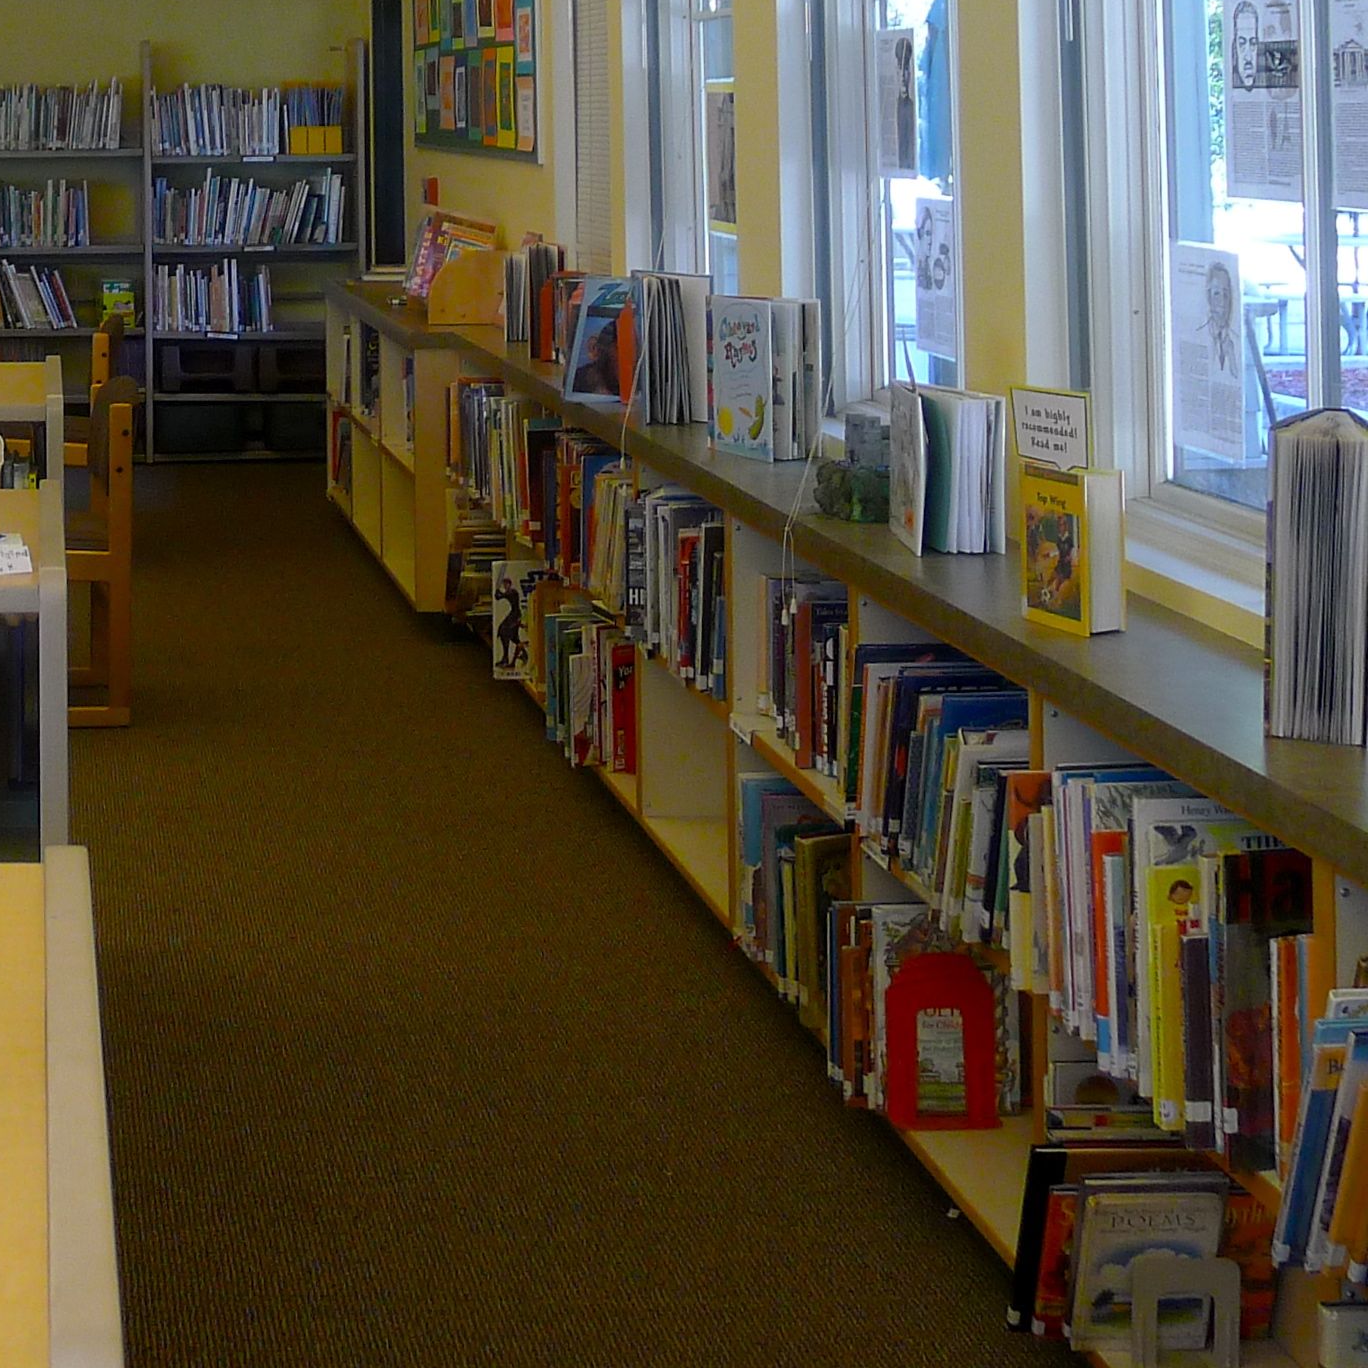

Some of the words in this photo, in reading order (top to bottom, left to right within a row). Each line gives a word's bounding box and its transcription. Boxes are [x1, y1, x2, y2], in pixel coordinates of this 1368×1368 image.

[1030, 408, 1042, 418] am
[1180, 804, 1211, 818] Henry
[1110, 1212, 1198, 1230] POEMS
